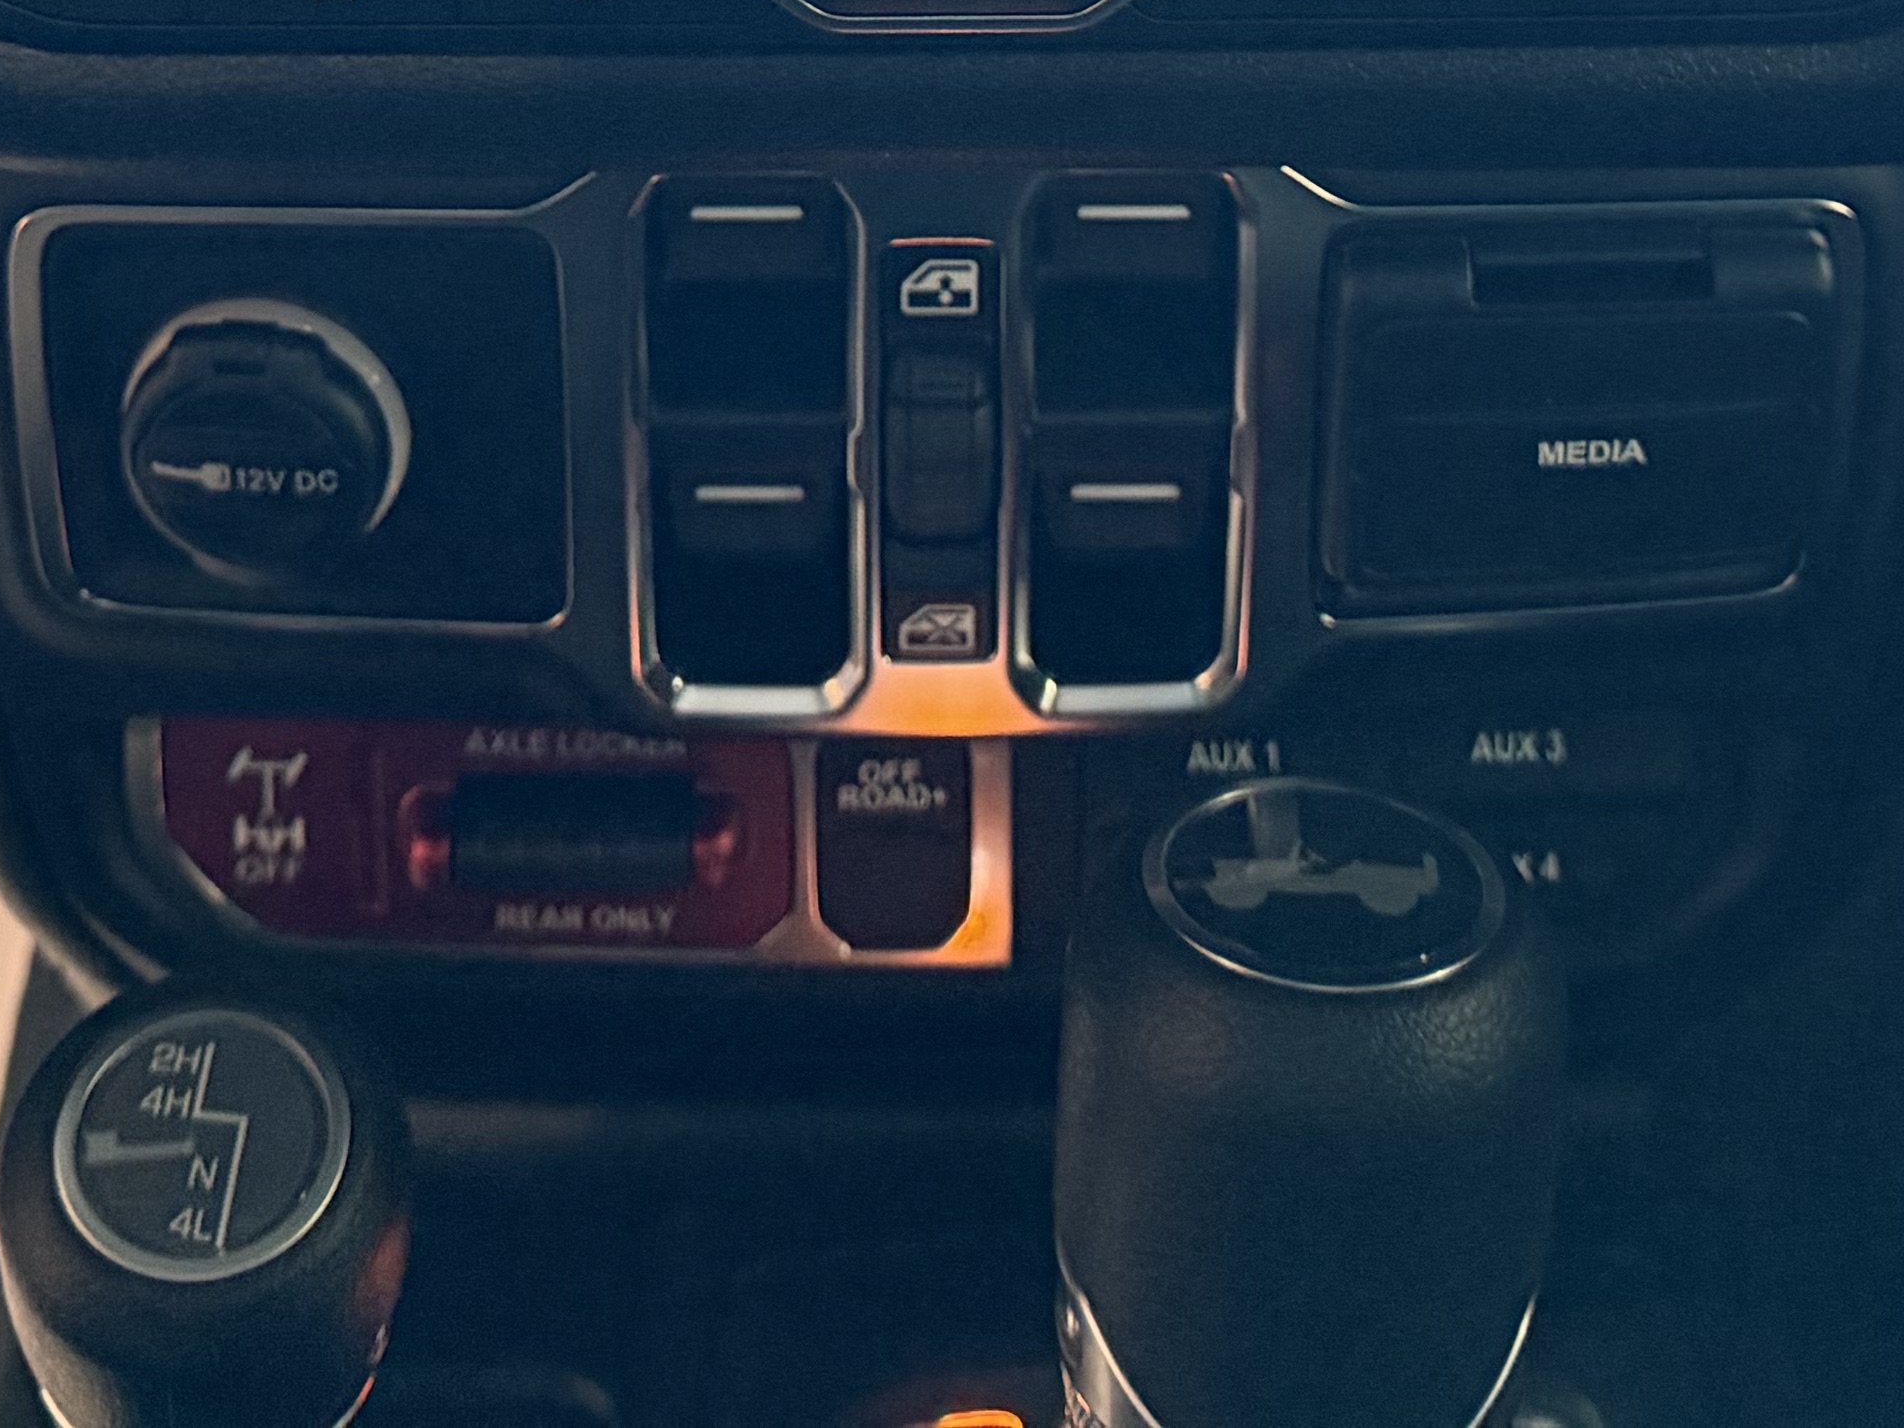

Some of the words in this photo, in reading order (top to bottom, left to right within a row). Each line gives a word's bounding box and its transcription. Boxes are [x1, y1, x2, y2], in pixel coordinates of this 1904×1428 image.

[1537, 440, 1646, 468] MEDIA
[234, 466, 286, 493] 12V
[295, 466, 339, 494] DC
[1188, 739, 1255, 774] AUX
[1264, 740, 1280, 772] 1
[1472, 732, 1538, 765] AUX
[858, 759, 921, 784] OFF
[496, 903, 582, 932] REAR
[591, 904, 677, 933] ONLY
[149, 1043, 202, 1073] 2H
[140, 1084, 192, 1118] 4H
[187, 1155, 218, 1190] N
[169, 1208, 212, 1240] 4L
